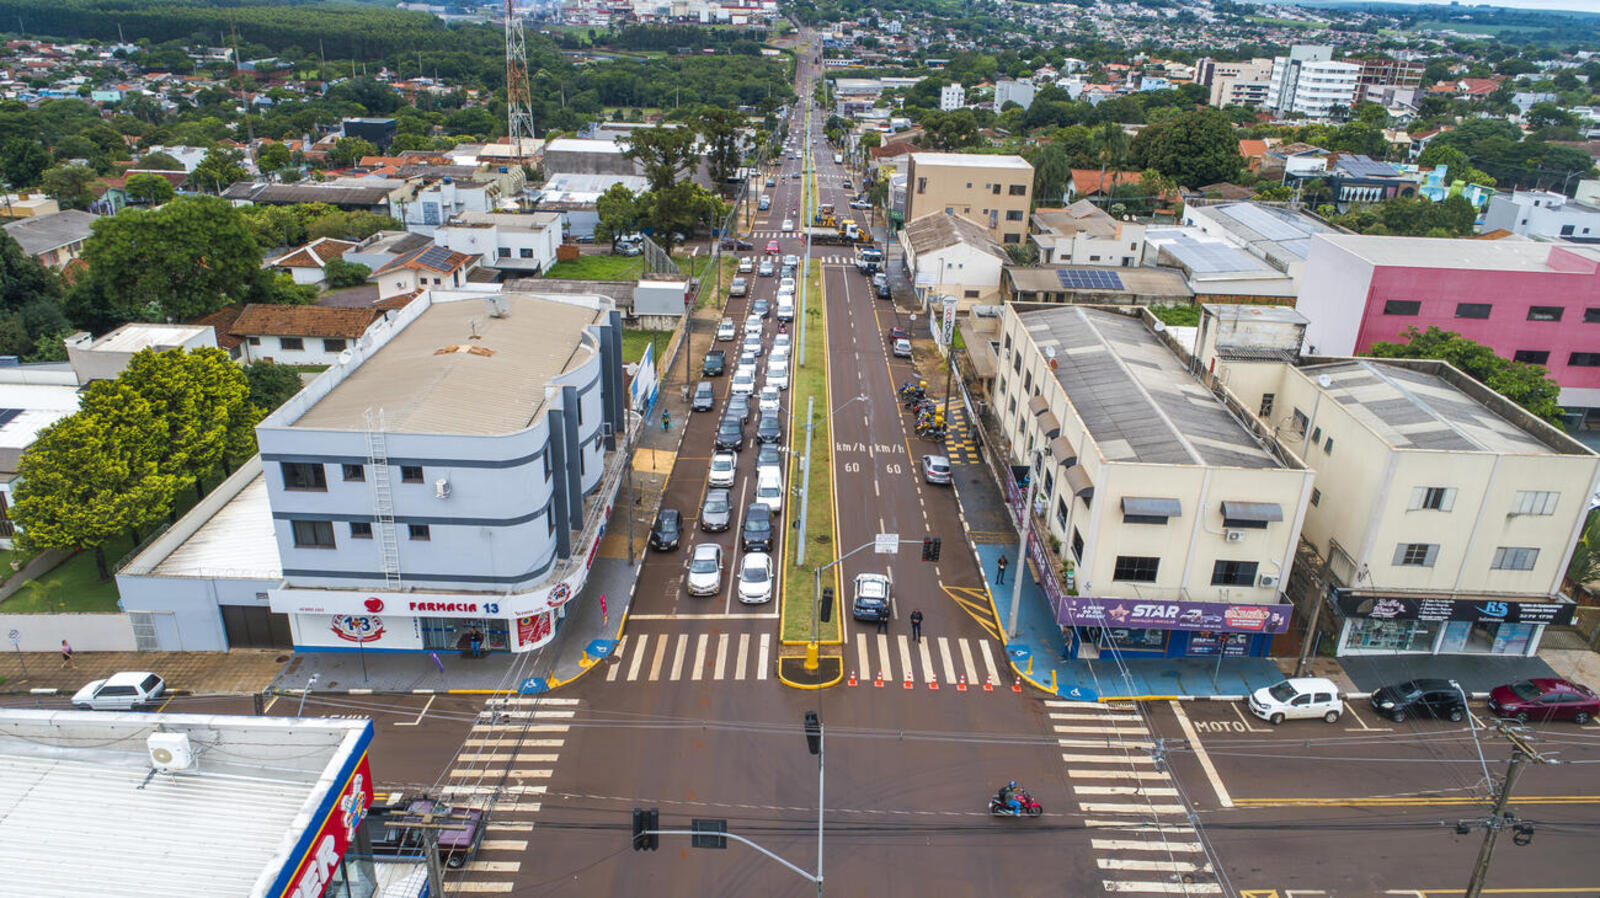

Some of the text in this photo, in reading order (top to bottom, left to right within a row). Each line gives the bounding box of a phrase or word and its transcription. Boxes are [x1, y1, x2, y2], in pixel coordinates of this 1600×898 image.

[836, 441, 905, 454] km/h km/h
[845, 462, 902, 475] 60 60
[409, 602, 500, 614] FARMACIA 13
[1131, 604, 1180, 618] STAR
[1193, 721, 1246, 733] MOTO
